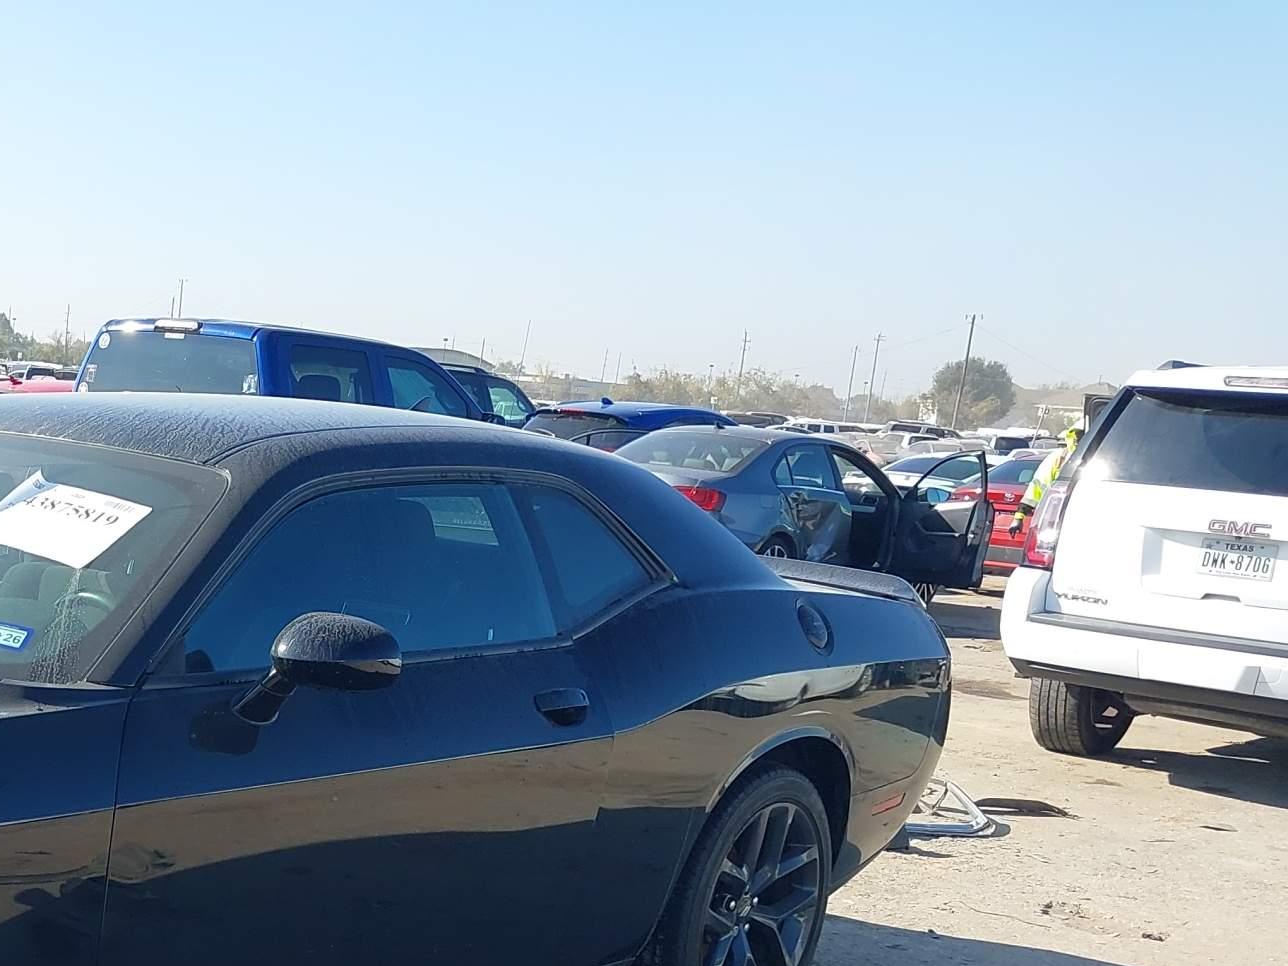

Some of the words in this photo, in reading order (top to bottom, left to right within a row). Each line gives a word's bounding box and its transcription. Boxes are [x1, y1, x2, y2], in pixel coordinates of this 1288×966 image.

[24, 496, 120, 526] 43875819
[1208, 519, 1272, 538] GMC
[1225, 542, 1255, 553] TEXAS
[2, 633, 22, 645] 26
